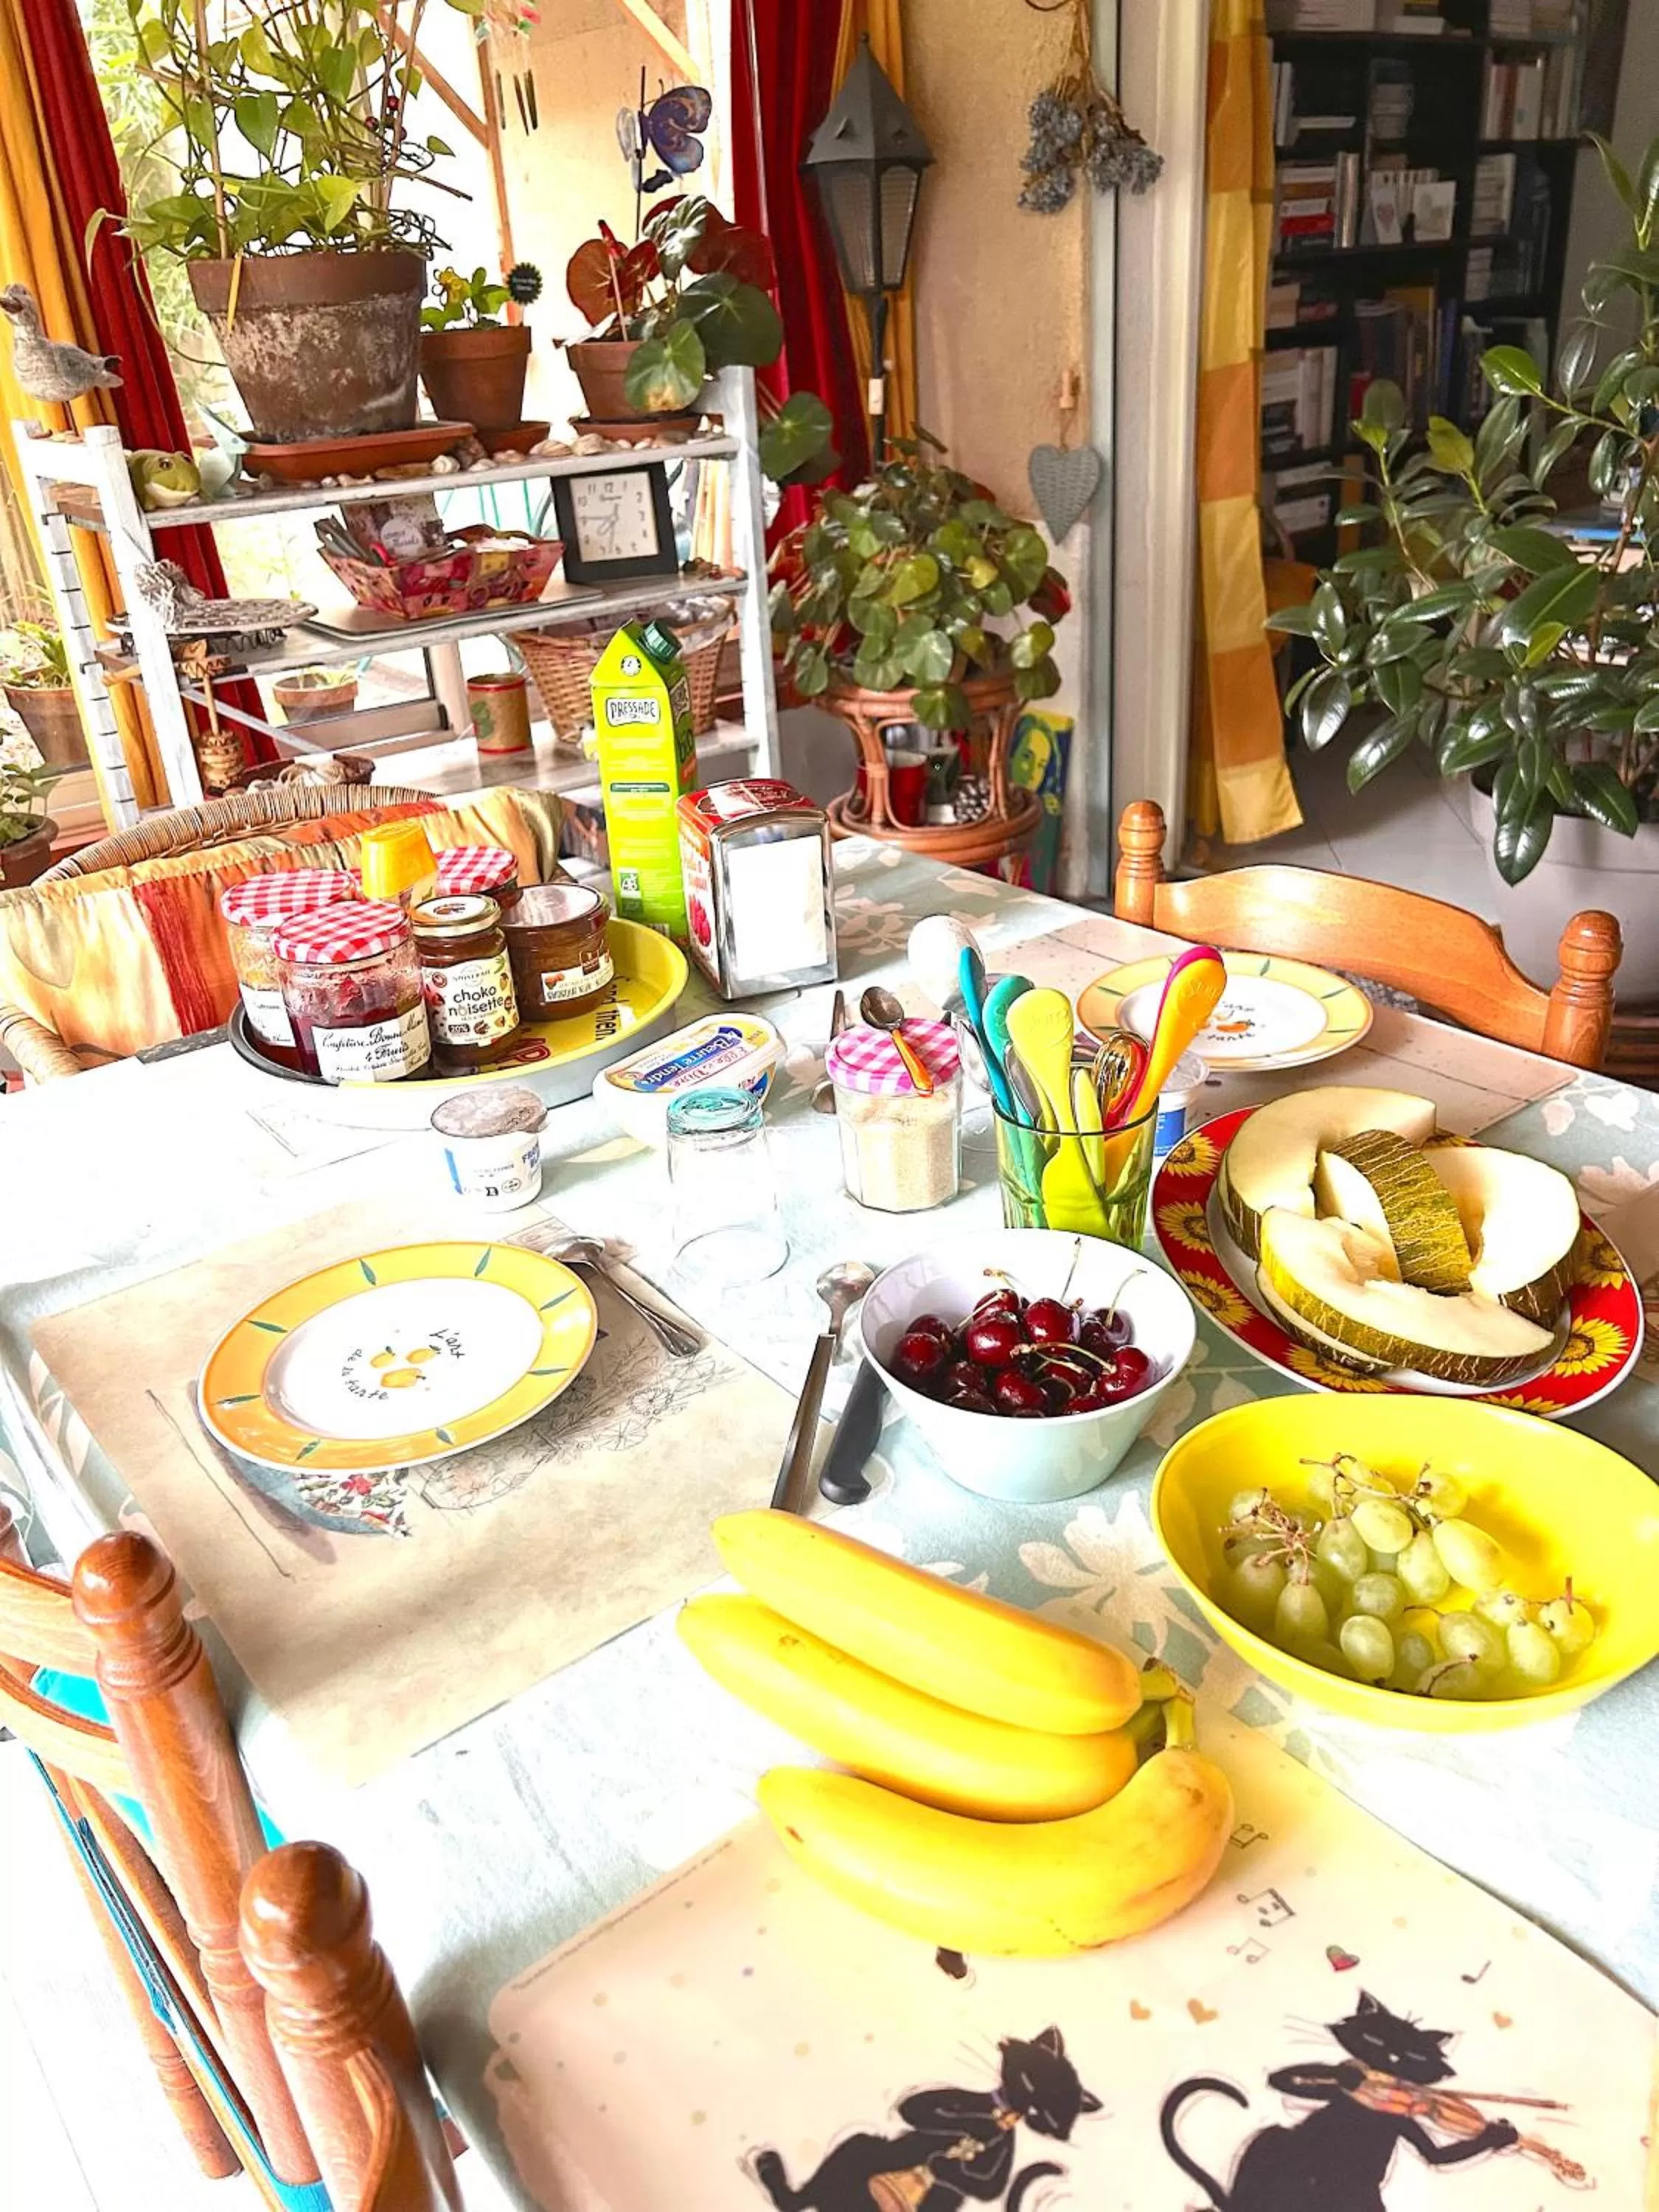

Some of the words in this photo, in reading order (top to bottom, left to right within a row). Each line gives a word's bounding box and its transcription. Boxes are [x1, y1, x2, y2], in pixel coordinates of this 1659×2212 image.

[610, 701, 655, 720] PRESSADE
[453, 986, 497, 1004] choko
[448, 997, 504, 1017] noisette
[683, 1034, 732, 1065] Beurre
